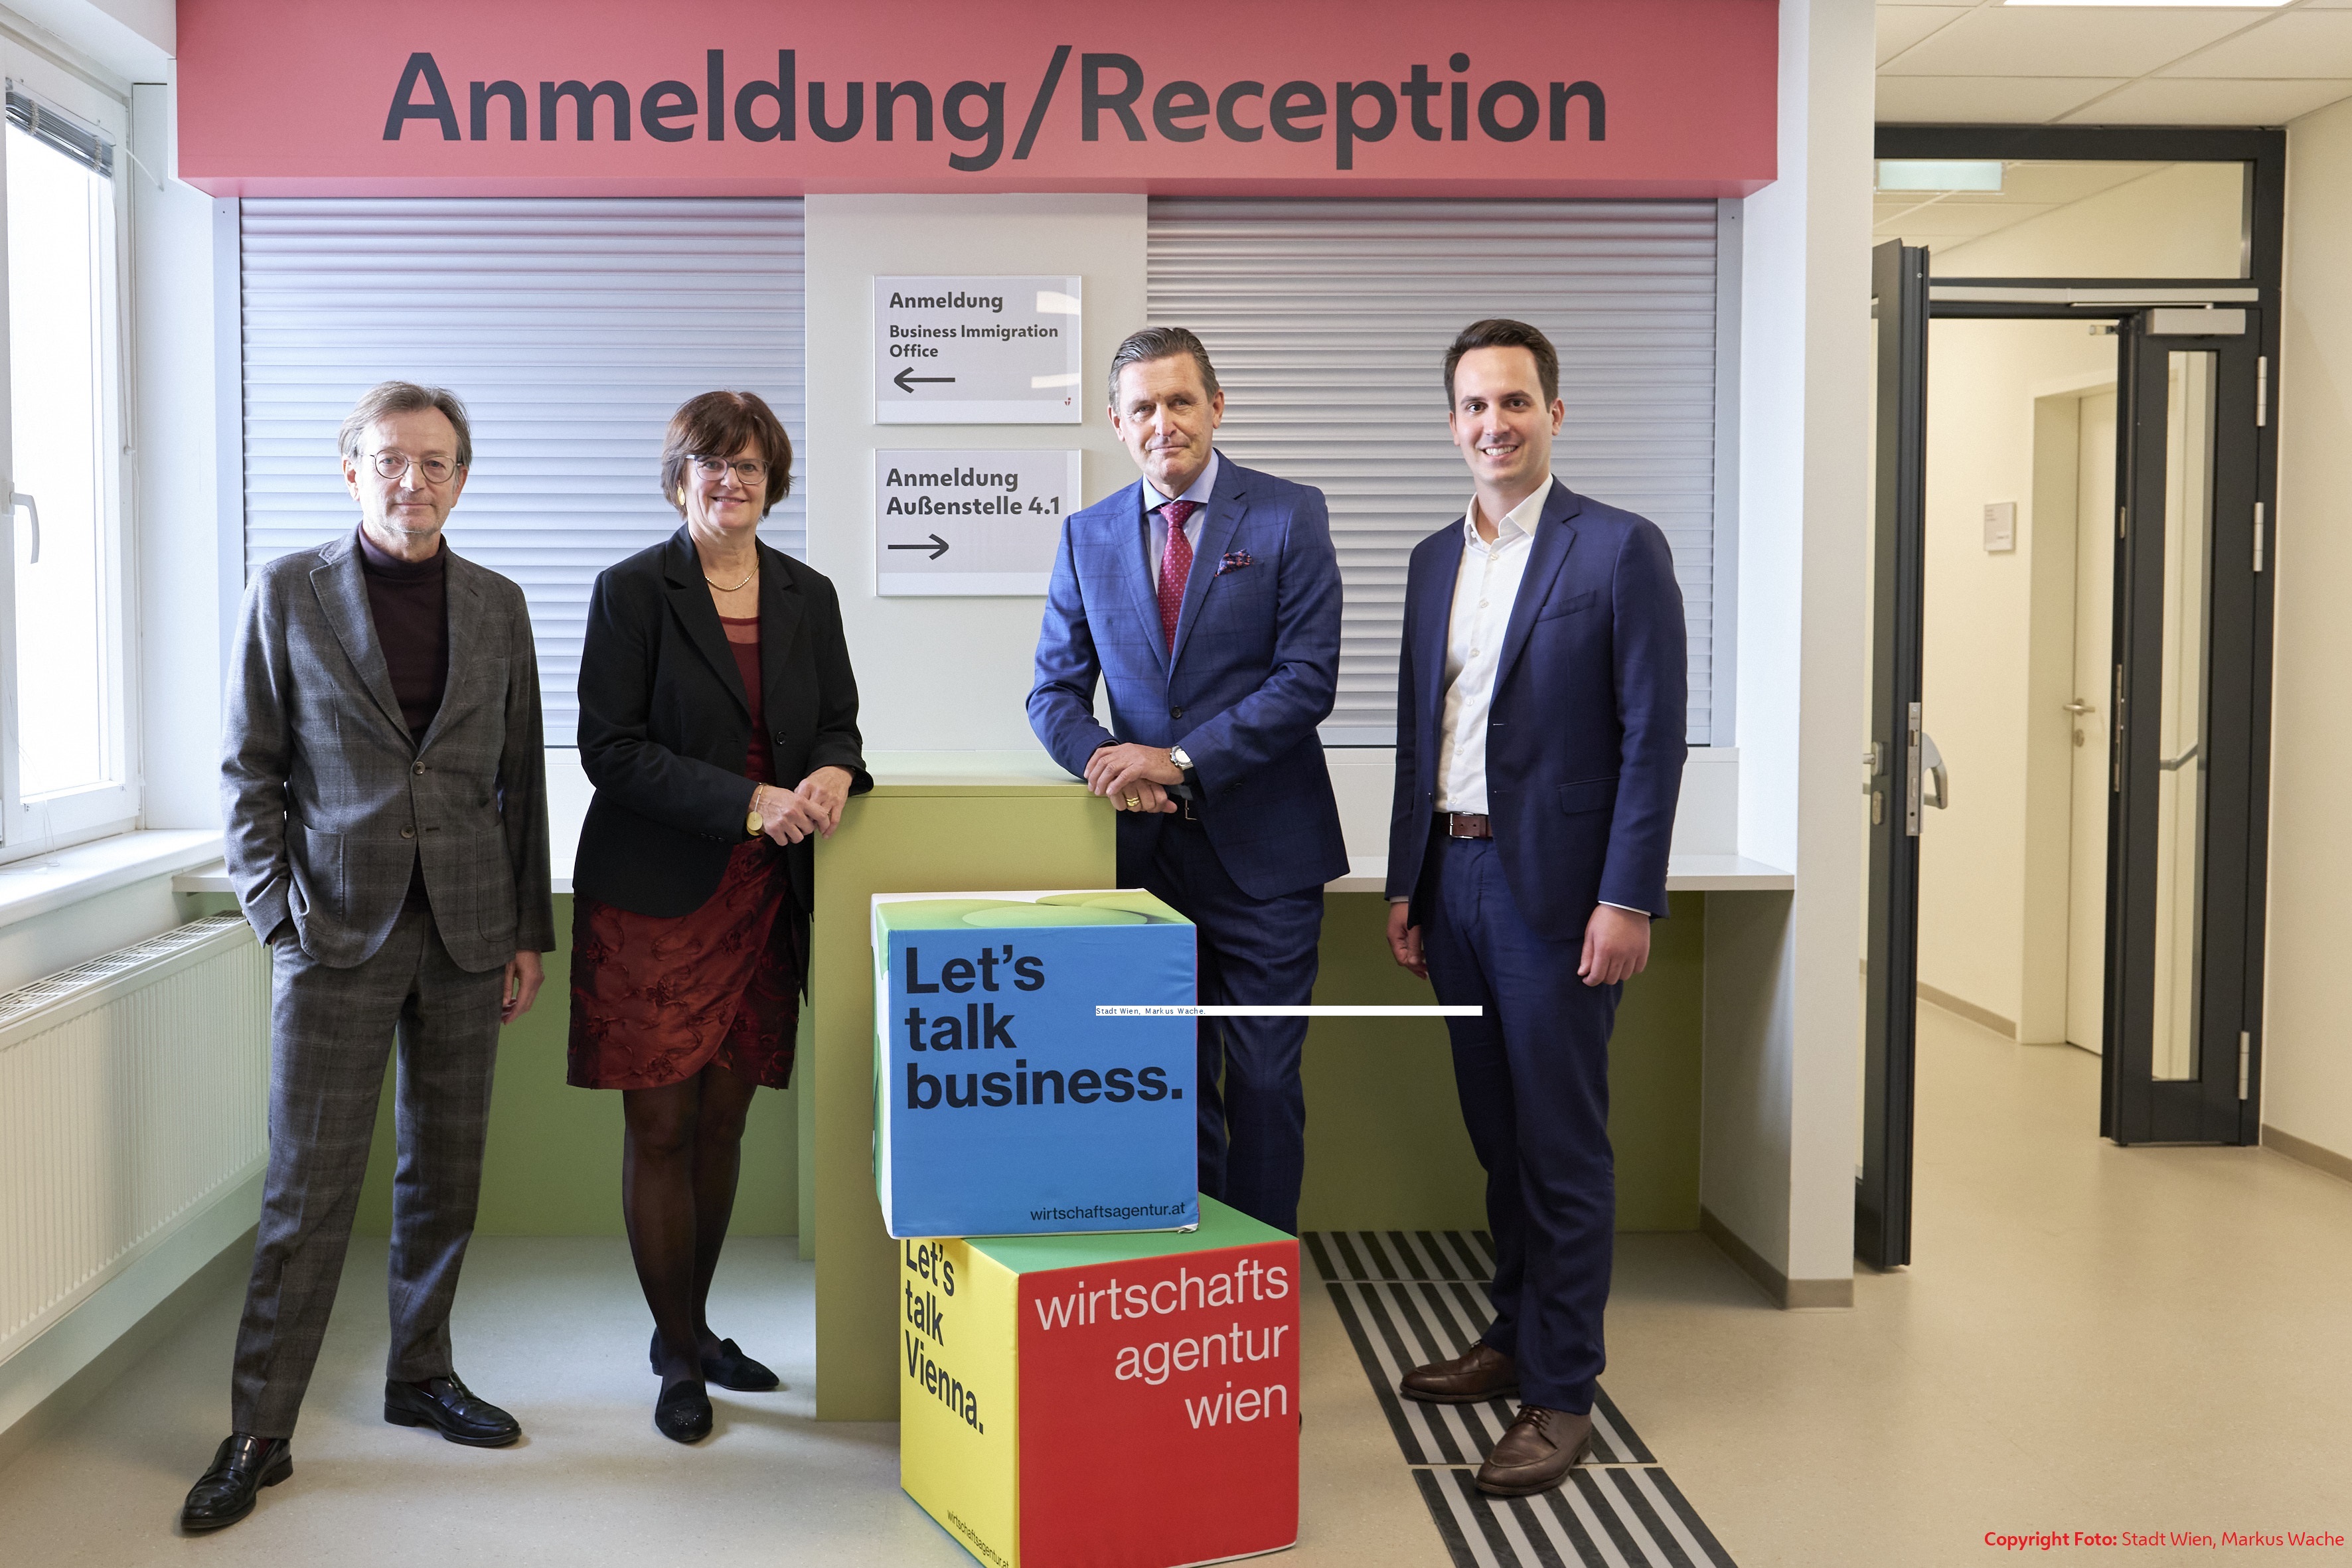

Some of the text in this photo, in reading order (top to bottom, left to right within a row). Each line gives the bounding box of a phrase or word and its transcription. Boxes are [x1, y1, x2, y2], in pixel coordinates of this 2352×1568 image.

[382, 44, 1607, 172] Anmeldung/Reception
[890, 291, 1003, 313] Anmeldung
[890, 324, 1058, 341] Business Immigration
[890, 343, 939, 358] Office
[886, 467, 1018, 492] Anmeldung
[887, 496, 1059, 515] Außenstelle 4.1
[905, 944, 1045, 994] Let’s
[905, 1002, 1017, 1052] talk
[907, 1059, 1183, 1110] business.
[1030, 1202, 1186, 1221] wirtschaftsagentur.at
[906, 1239, 955, 1296] Let’s
[905, 1279, 944, 1347] talk
[1035, 1259, 1289, 1331] wirtschafts
[1115, 1322, 1289, 1385] agentur
[905, 1330, 984, 1435] Vienna.
[1185, 1381, 1288, 1429] wien
[947, 1509, 1009, 1568] wirtschaftsagentur.at
